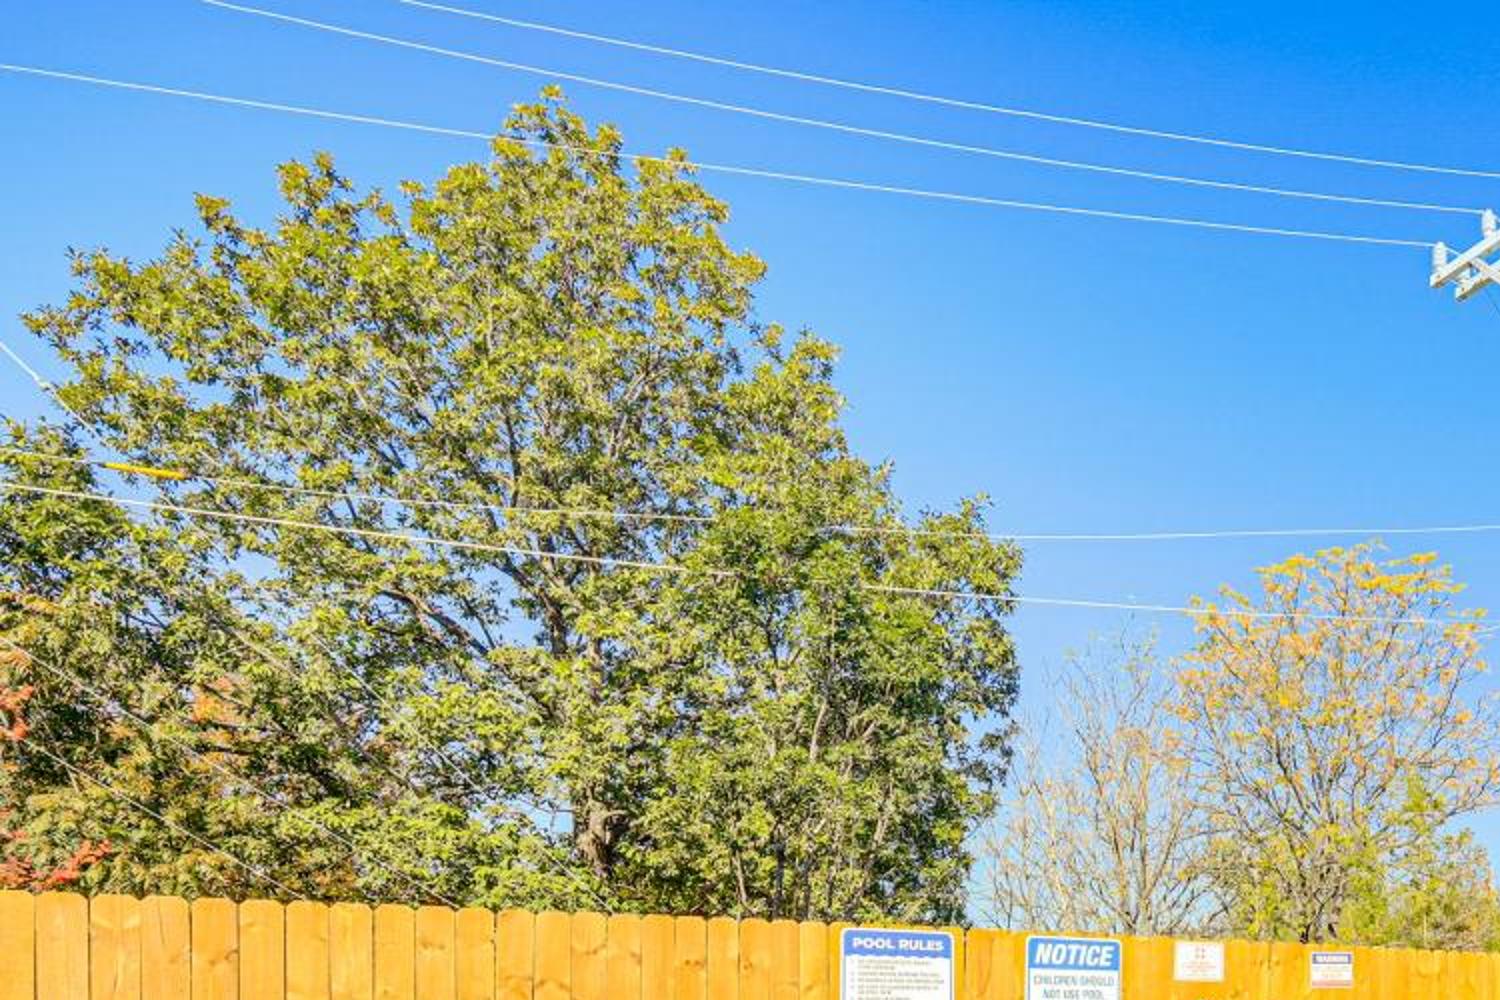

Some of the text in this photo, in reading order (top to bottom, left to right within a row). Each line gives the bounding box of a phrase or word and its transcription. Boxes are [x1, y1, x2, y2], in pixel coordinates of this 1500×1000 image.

[852, 937, 944, 951] POOL RULES
[1034, 943, 1115, 967] NOTICE
[1033, 975, 1115, 987] CHILDREN SHOULD
[1042, 989, 1104, 1000] NOT USE POOL
